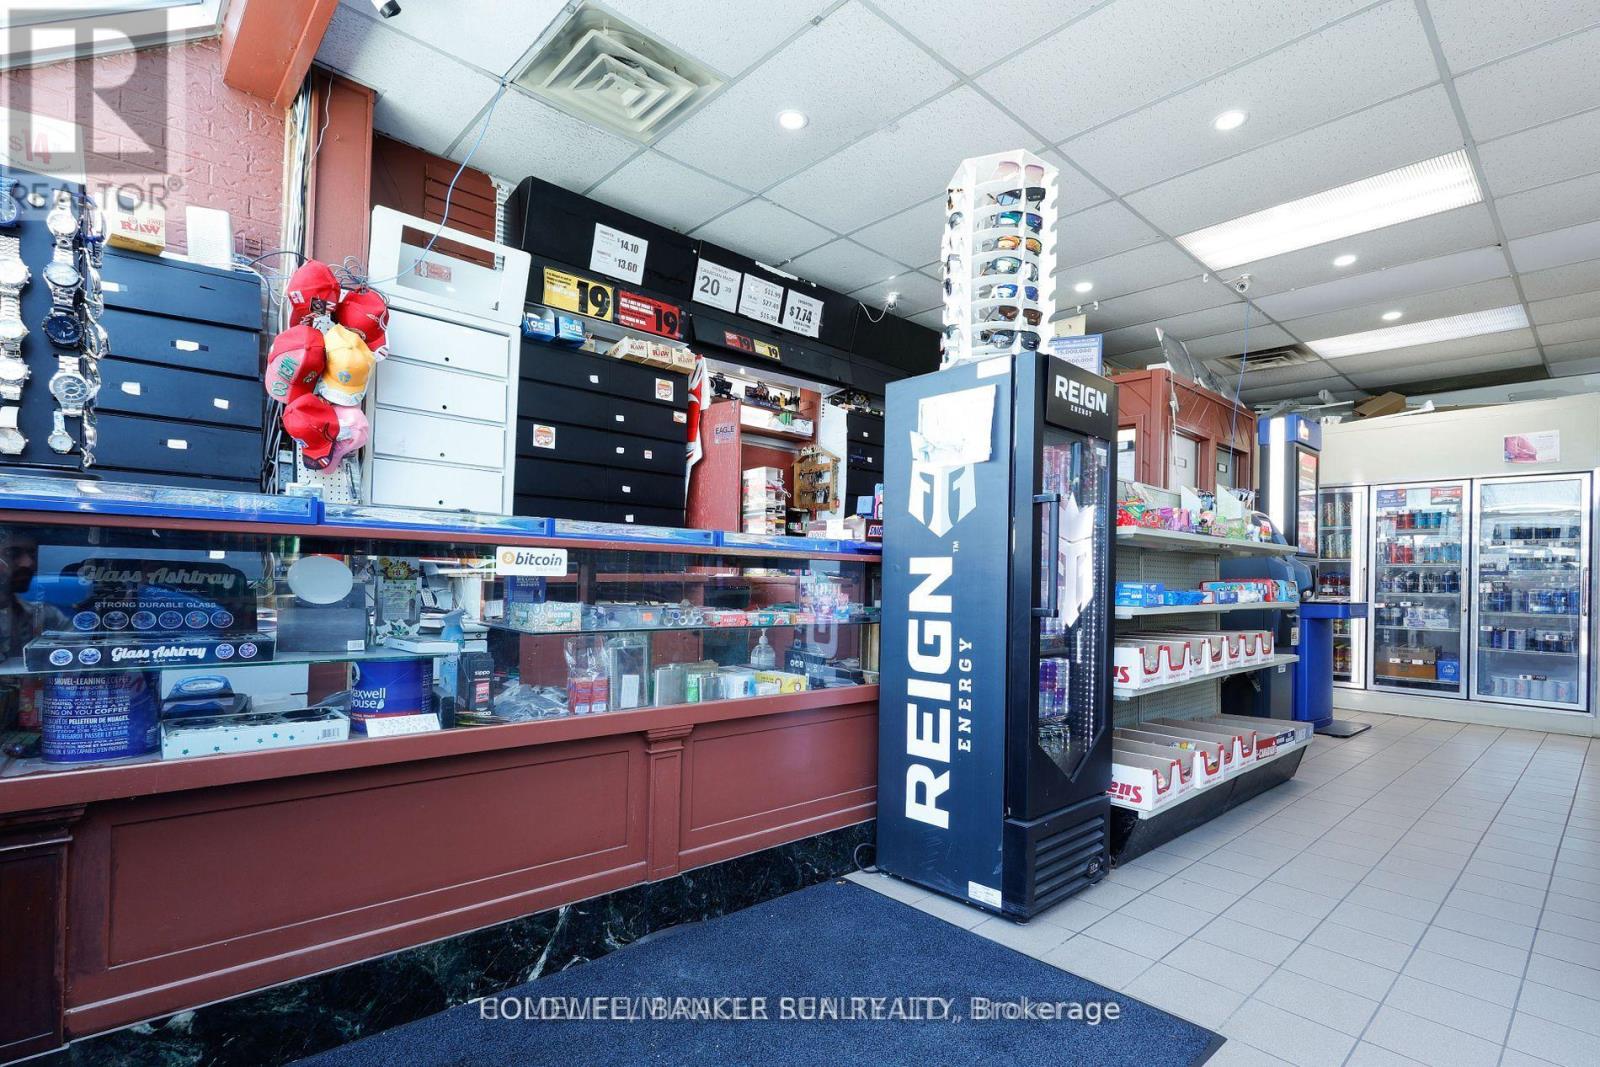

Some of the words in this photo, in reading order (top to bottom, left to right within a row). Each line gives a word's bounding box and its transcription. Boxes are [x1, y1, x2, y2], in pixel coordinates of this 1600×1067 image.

[577, 280, 611, 318] 19
[654, 308, 679, 335] 19
[1054, 374, 1109, 414] REIGN
[515, 551, 563, 566] bitcoin
[77, 565, 143, 586] Glass
[147, 566, 236, 589] Ashtray
[94, 601, 136, 609] STRONG
[139, 601, 184, 609] DURABLE
[186, 601, 216, 609] GLASS
[111, 646, 150, 662] Glass
[152, 646, 207, 661] Ashtray
[352, 687, 386, 699] axwell
[352, 698, 377, 709] ouse
[905, 556, 953, 829] REIGN
[957, 637, 973, 753] ENERGY
